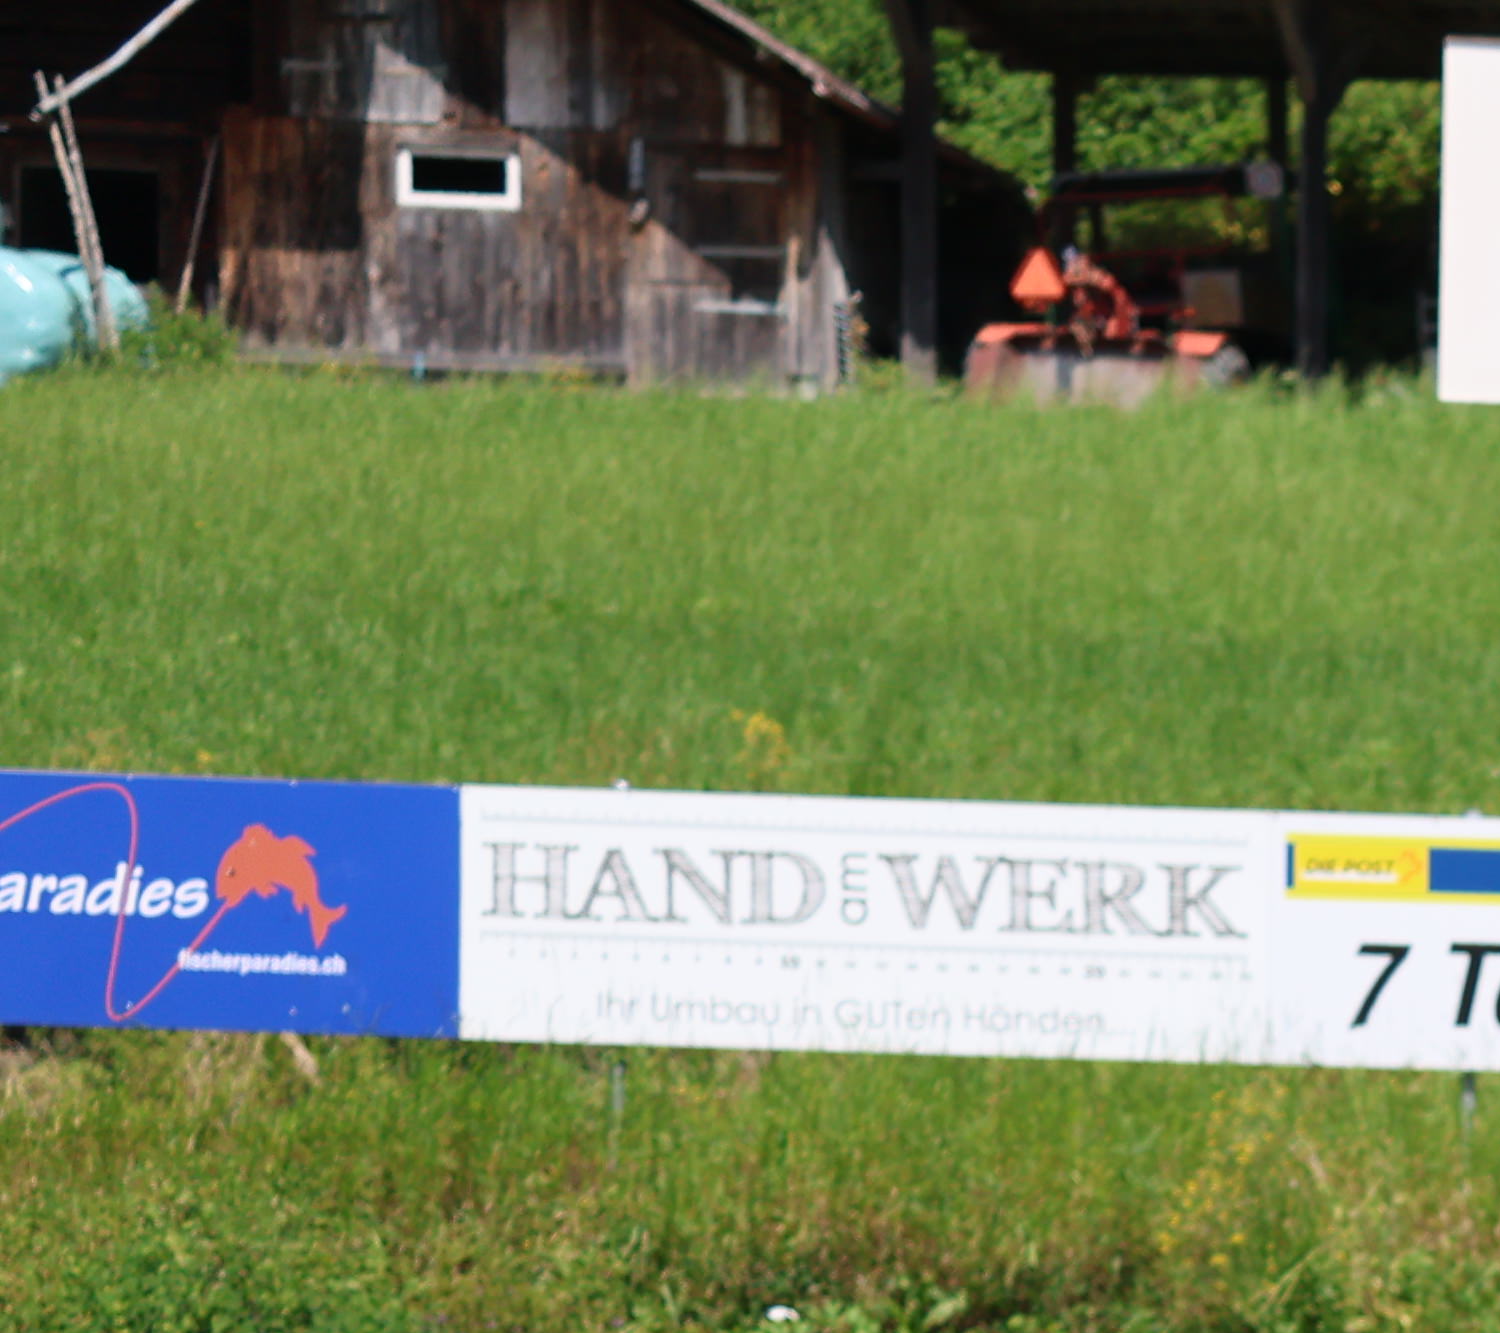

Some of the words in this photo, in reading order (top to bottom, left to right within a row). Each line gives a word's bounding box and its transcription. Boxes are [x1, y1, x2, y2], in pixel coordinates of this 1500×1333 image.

[481, 841, 827, 925] HAND
[878, 852, 1249, 939] WERK
[177, 947, 347, 976] fischerparadies.ch
[1351, 943, 1412, 1029] 7
[649, 991, 781, 1027] Umbau
